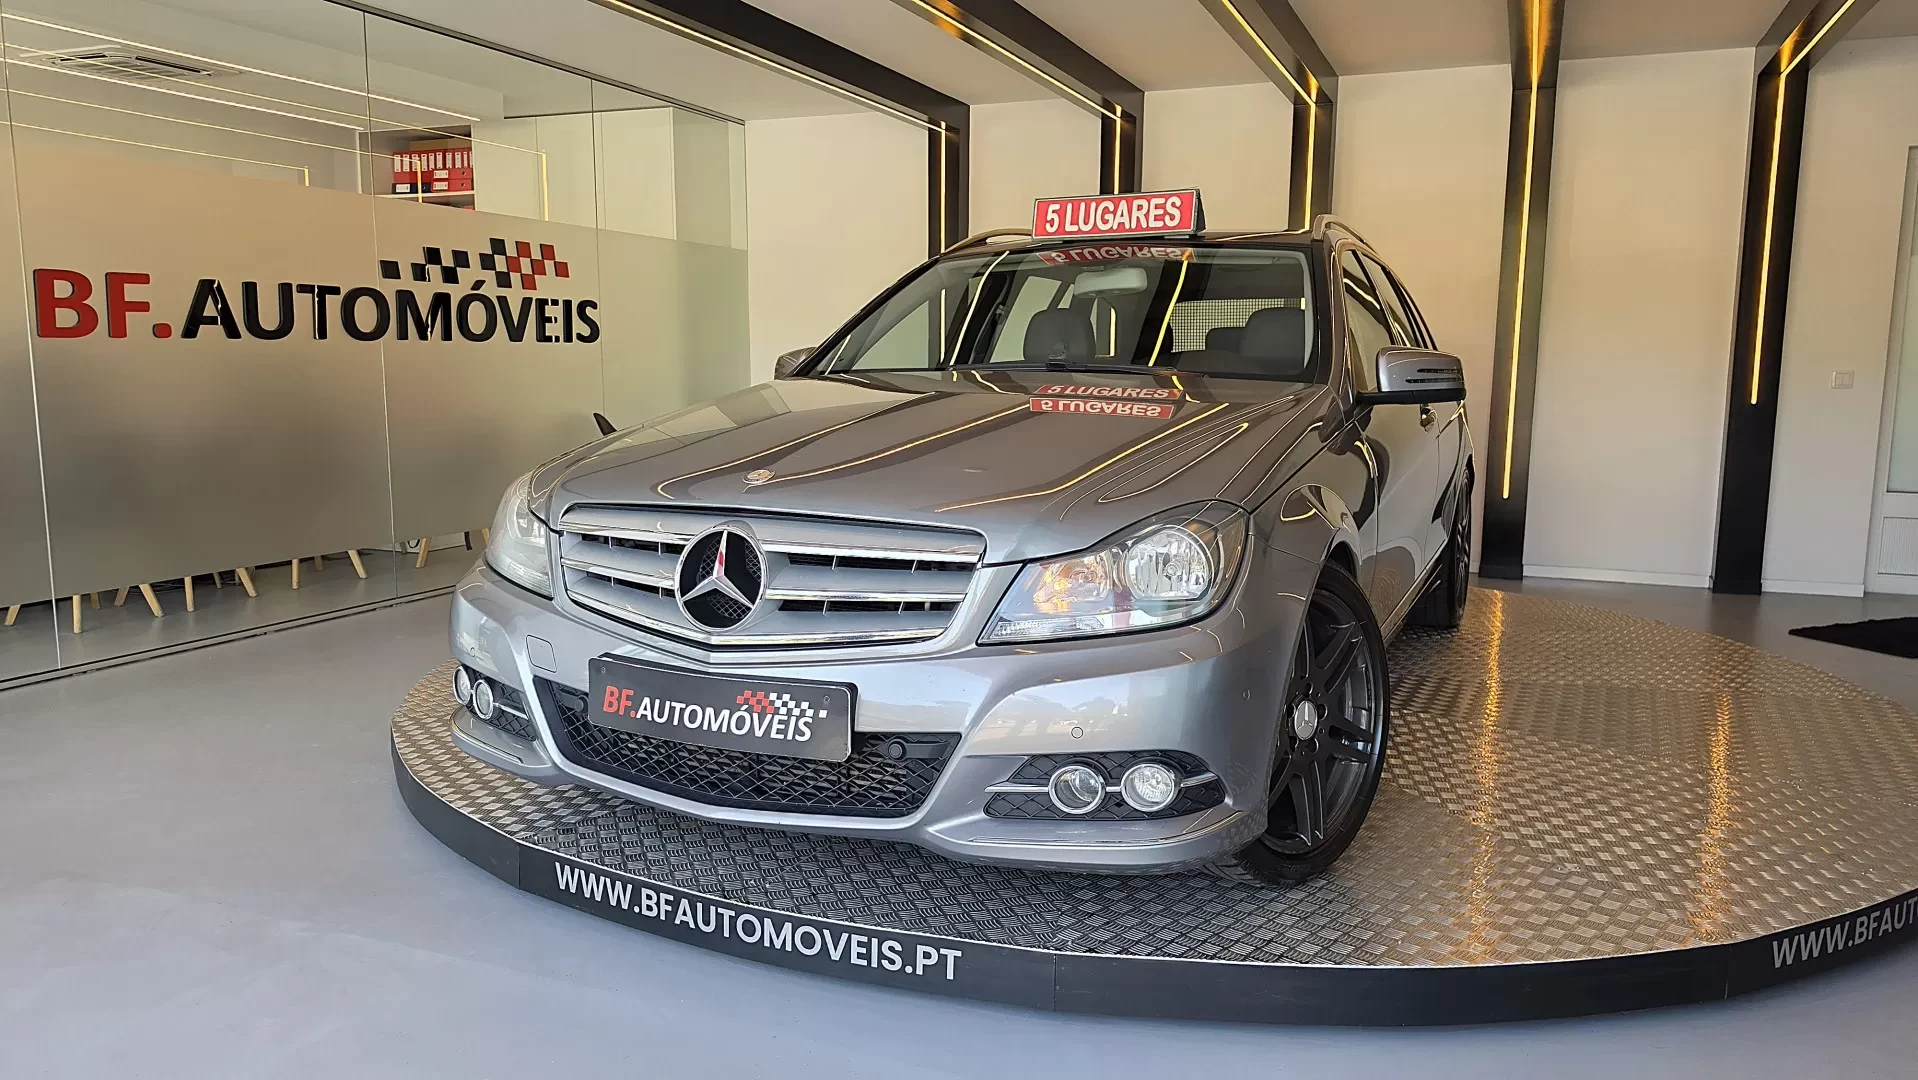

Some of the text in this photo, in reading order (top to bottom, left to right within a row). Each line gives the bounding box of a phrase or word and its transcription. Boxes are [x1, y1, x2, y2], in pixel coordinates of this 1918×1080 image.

[1046, 196, 1182, 233] 5 LUGARES
[33, 268, 601, 344] BF.AUTOMÓVEIS
[1065, 385, 1169, 398] LUGARES
[602, 685, 814, 742] BF.AUTOMÓVEIS
[554, 861, 962, 980] WWW.BFAUTOMOVEIS.PT
[1772, 896, 1918, 969] WWW.BFAUT
